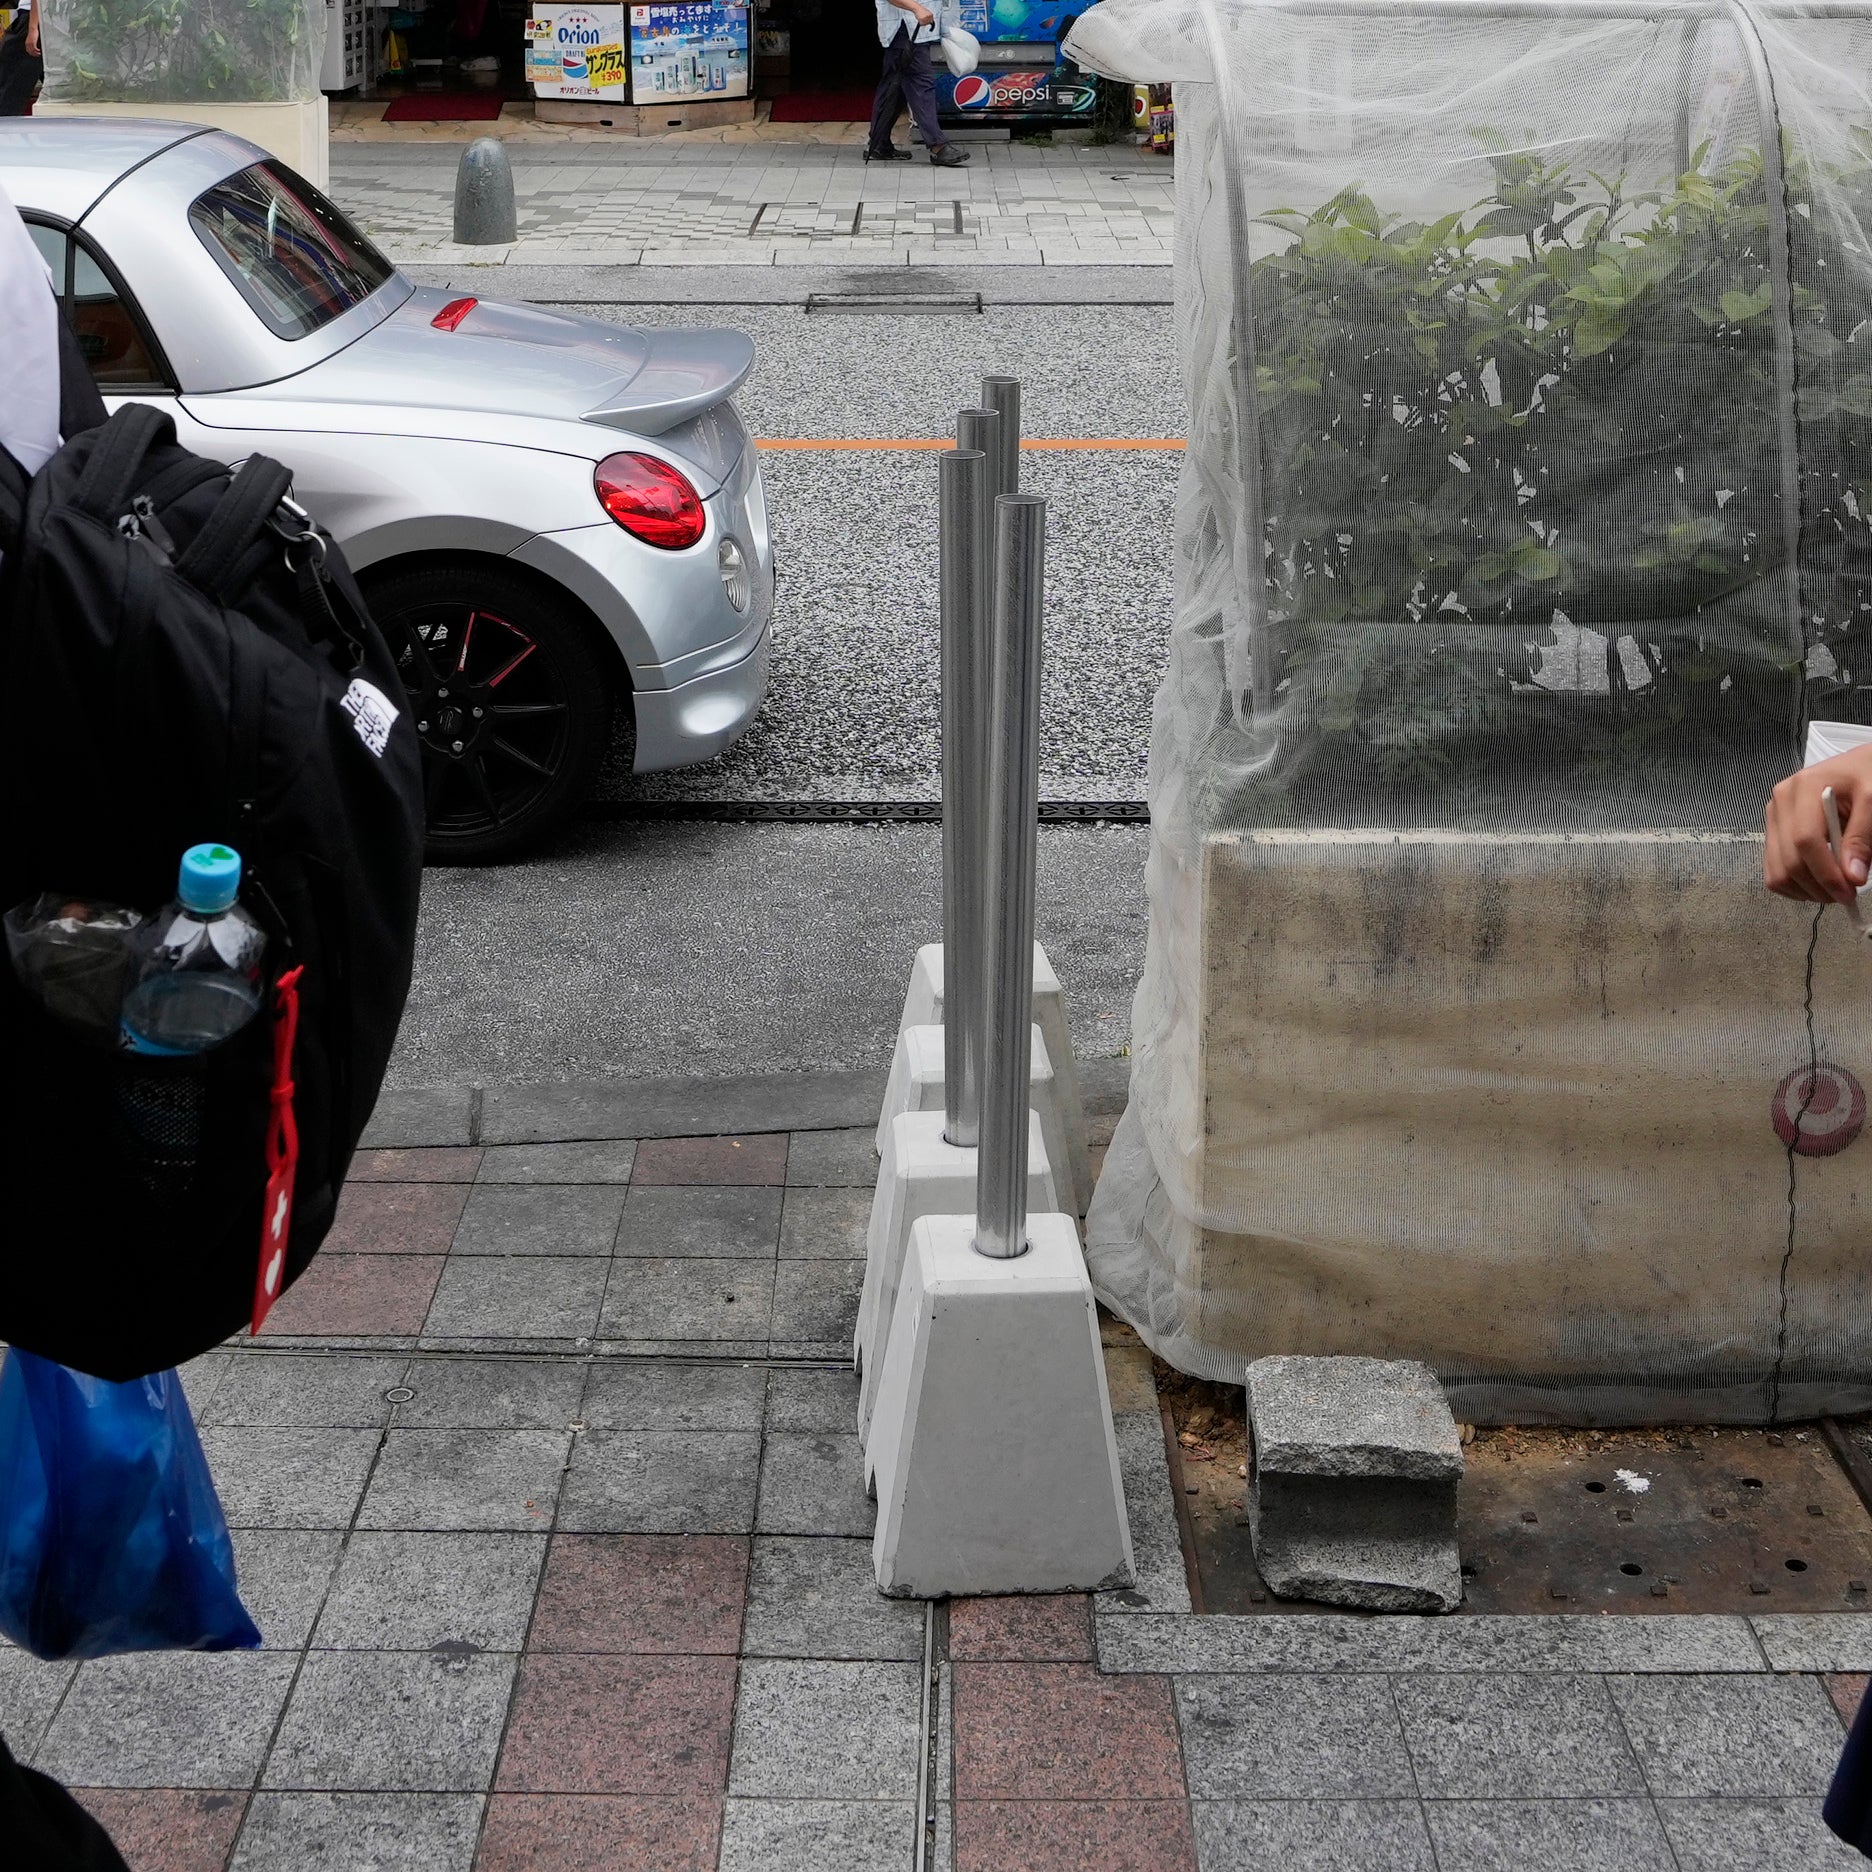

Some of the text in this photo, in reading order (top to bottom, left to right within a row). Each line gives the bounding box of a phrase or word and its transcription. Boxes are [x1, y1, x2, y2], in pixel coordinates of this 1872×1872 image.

[650, 5, 729, 18] 雪塩売ってます
[558, 24, 600, 45] Orion
[585, 50, 625, 75] サングラス
[994, 83, 1051, 105] pepsi
